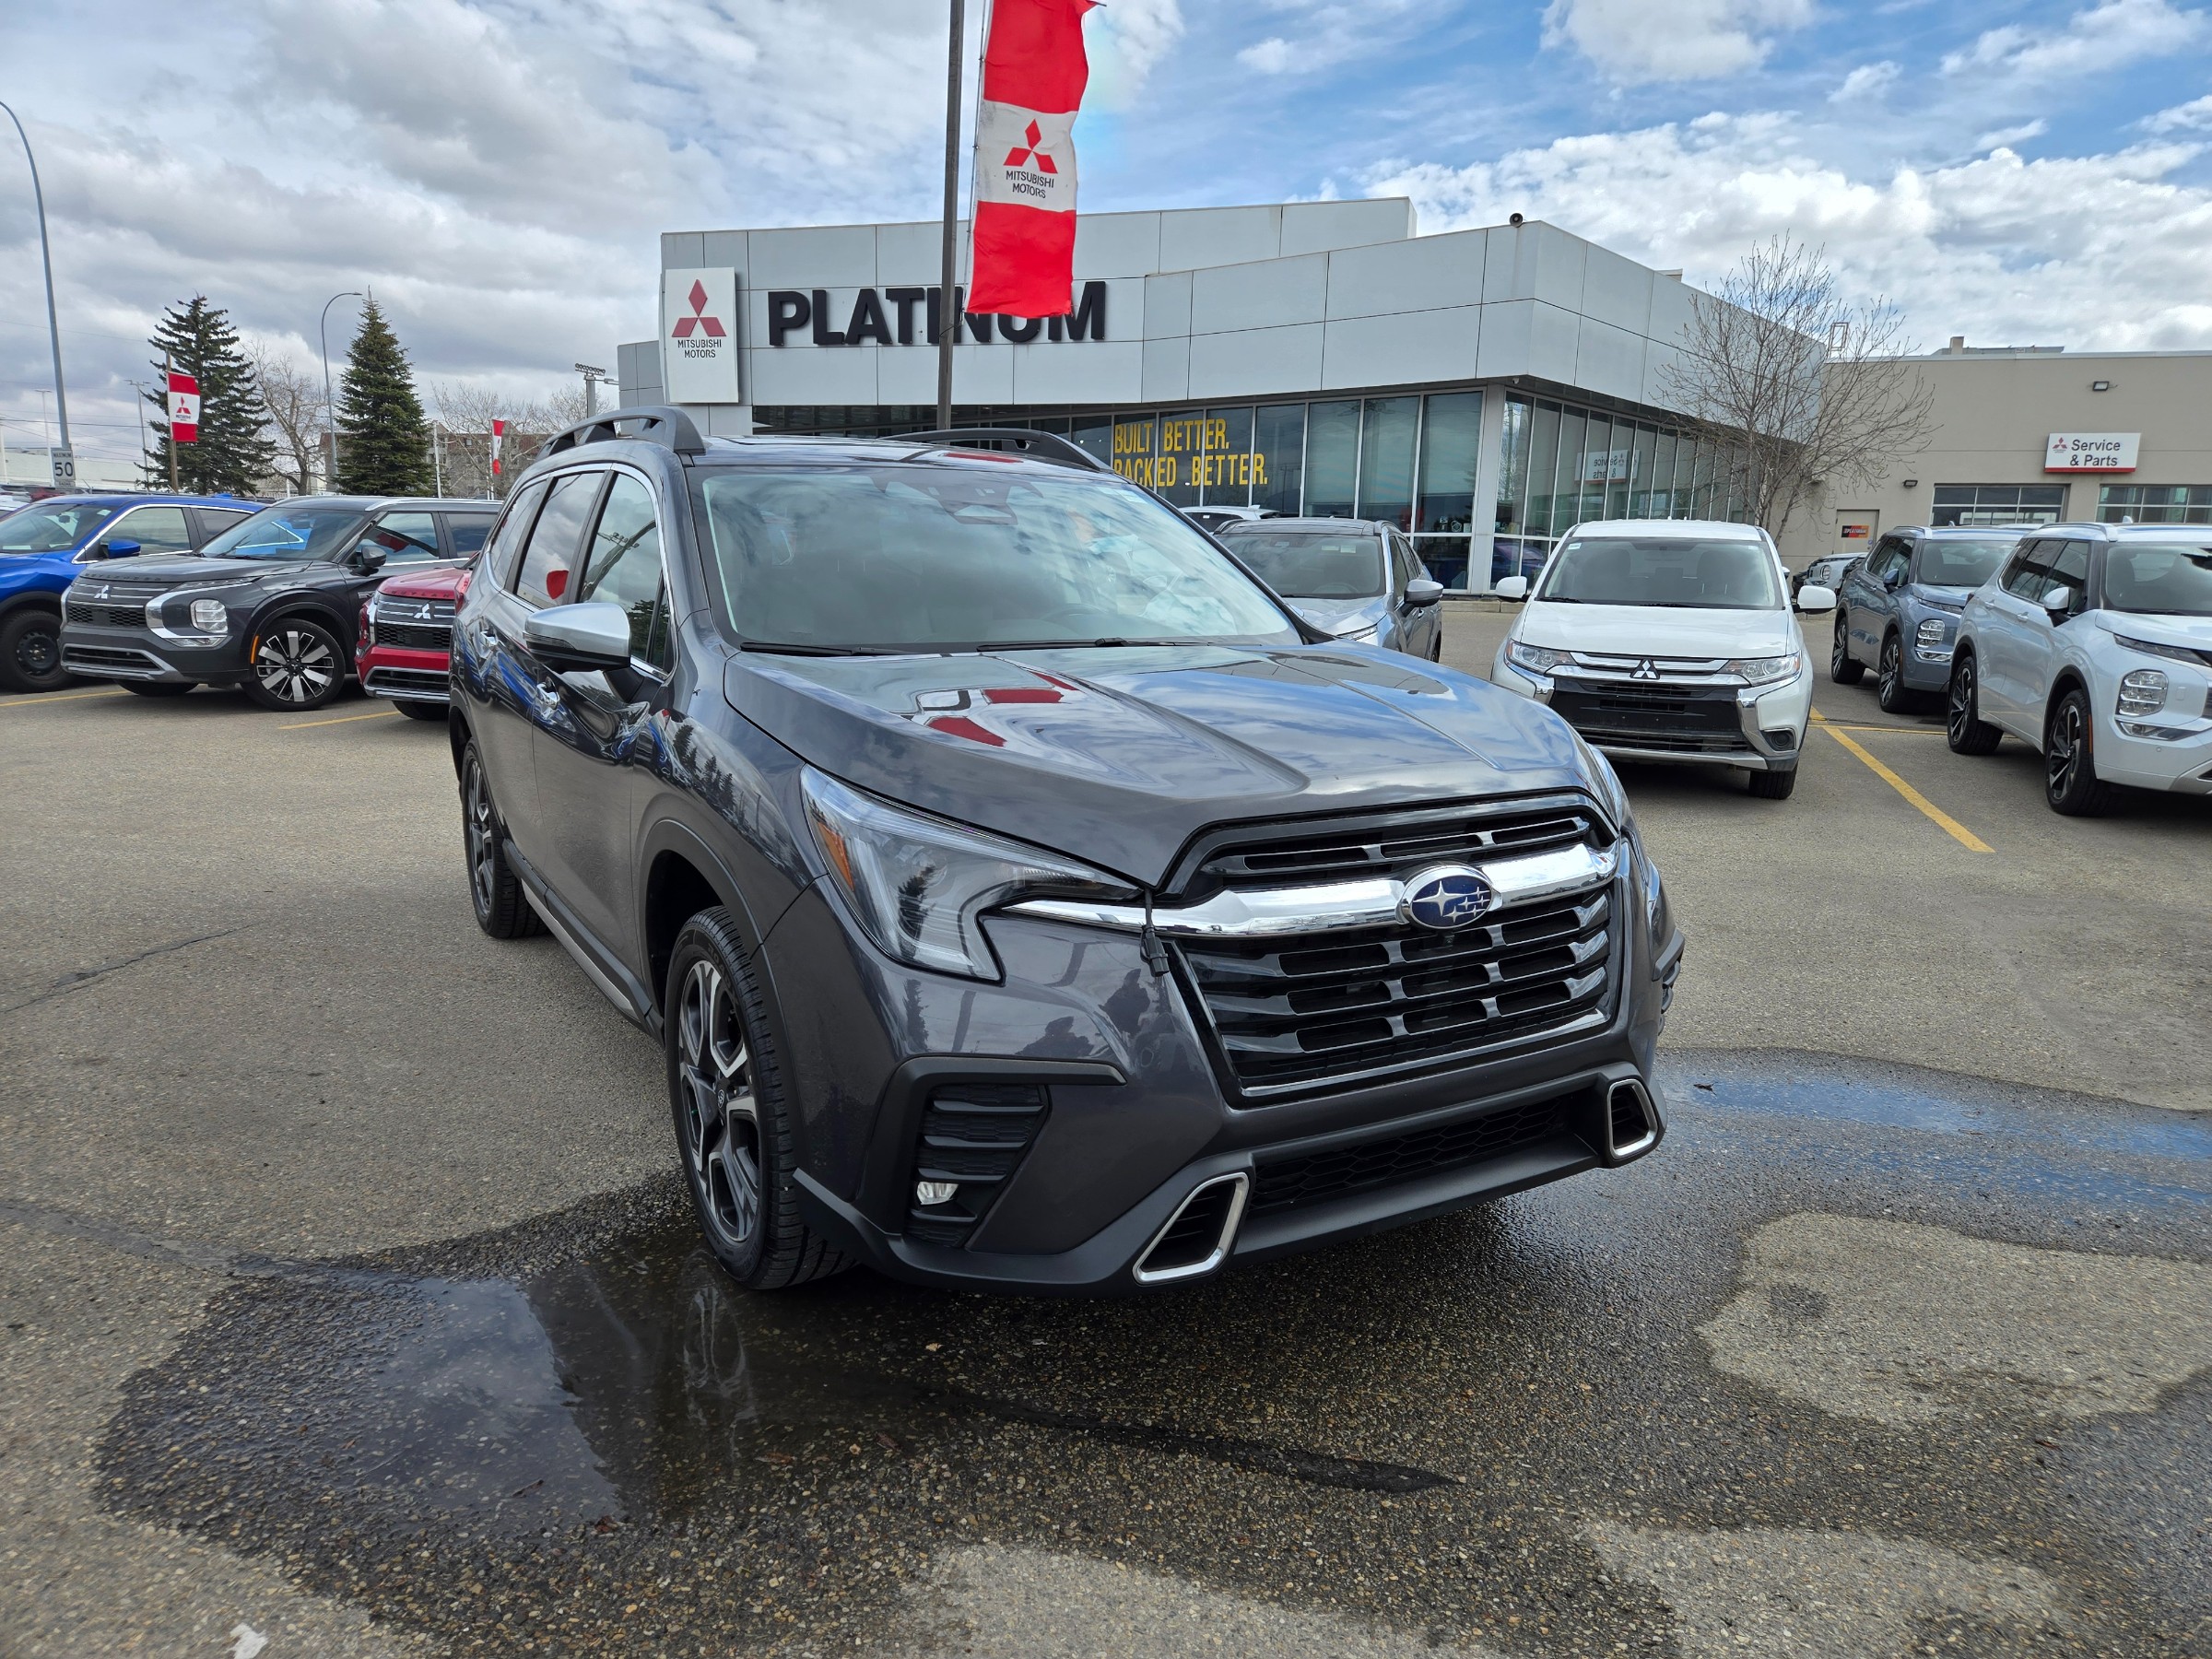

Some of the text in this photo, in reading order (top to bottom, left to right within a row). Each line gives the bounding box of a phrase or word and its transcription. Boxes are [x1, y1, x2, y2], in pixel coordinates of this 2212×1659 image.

[1006, 170, 1054, 188] MITSUBISHI
[1012, 182, 1046, 199] MOTORS
[768, 280, 1107, 346] PLATINUM
[677, 339, 722, 348] MITSUBISHI
[684, 349, 716, 359] MOTORS
[1114, 418, 1230, 454] BUILT BETTER.
[2071, 439, 2121, 451] Service
[2070, 454, 2118, 466] & Parts
[54, 462, 74, 477] 50
[1192, 453, 1268, 487] BETTER.
